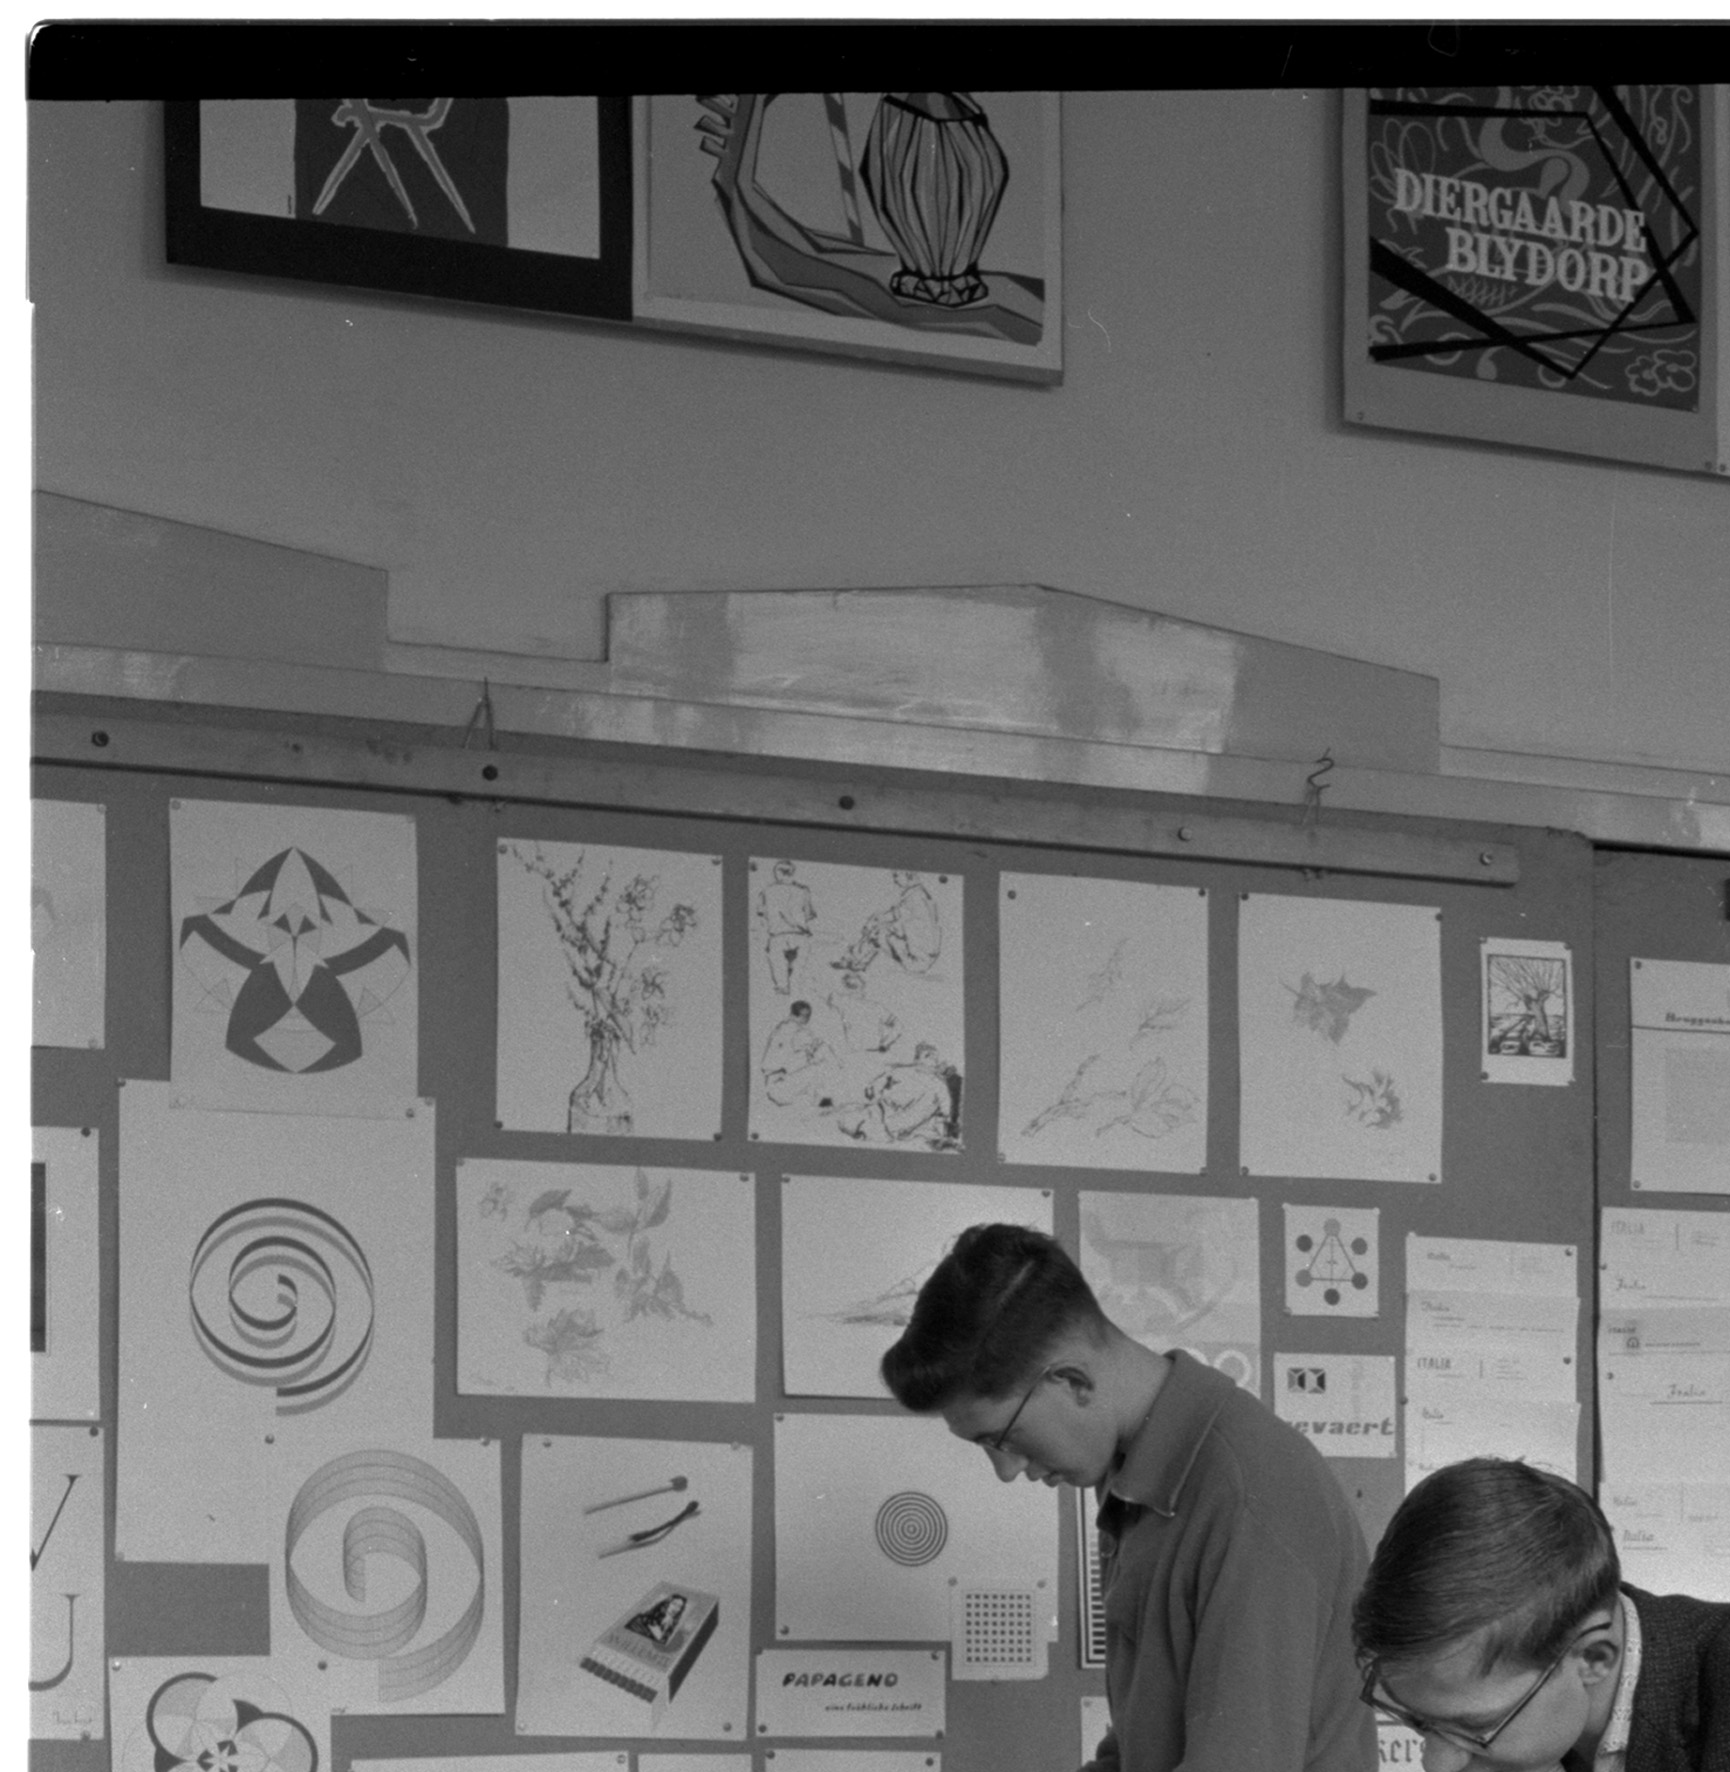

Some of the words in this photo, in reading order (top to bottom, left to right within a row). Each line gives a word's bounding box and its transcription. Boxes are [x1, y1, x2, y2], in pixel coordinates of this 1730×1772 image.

[1392, 167, 1647, 253] DIERGAARDE
[1445, 227, 1649, 302] BLYDORP
[1287, 1416, 1394, 1436] evaert
[782, 1671, 898, 1688] PAPAGENO
